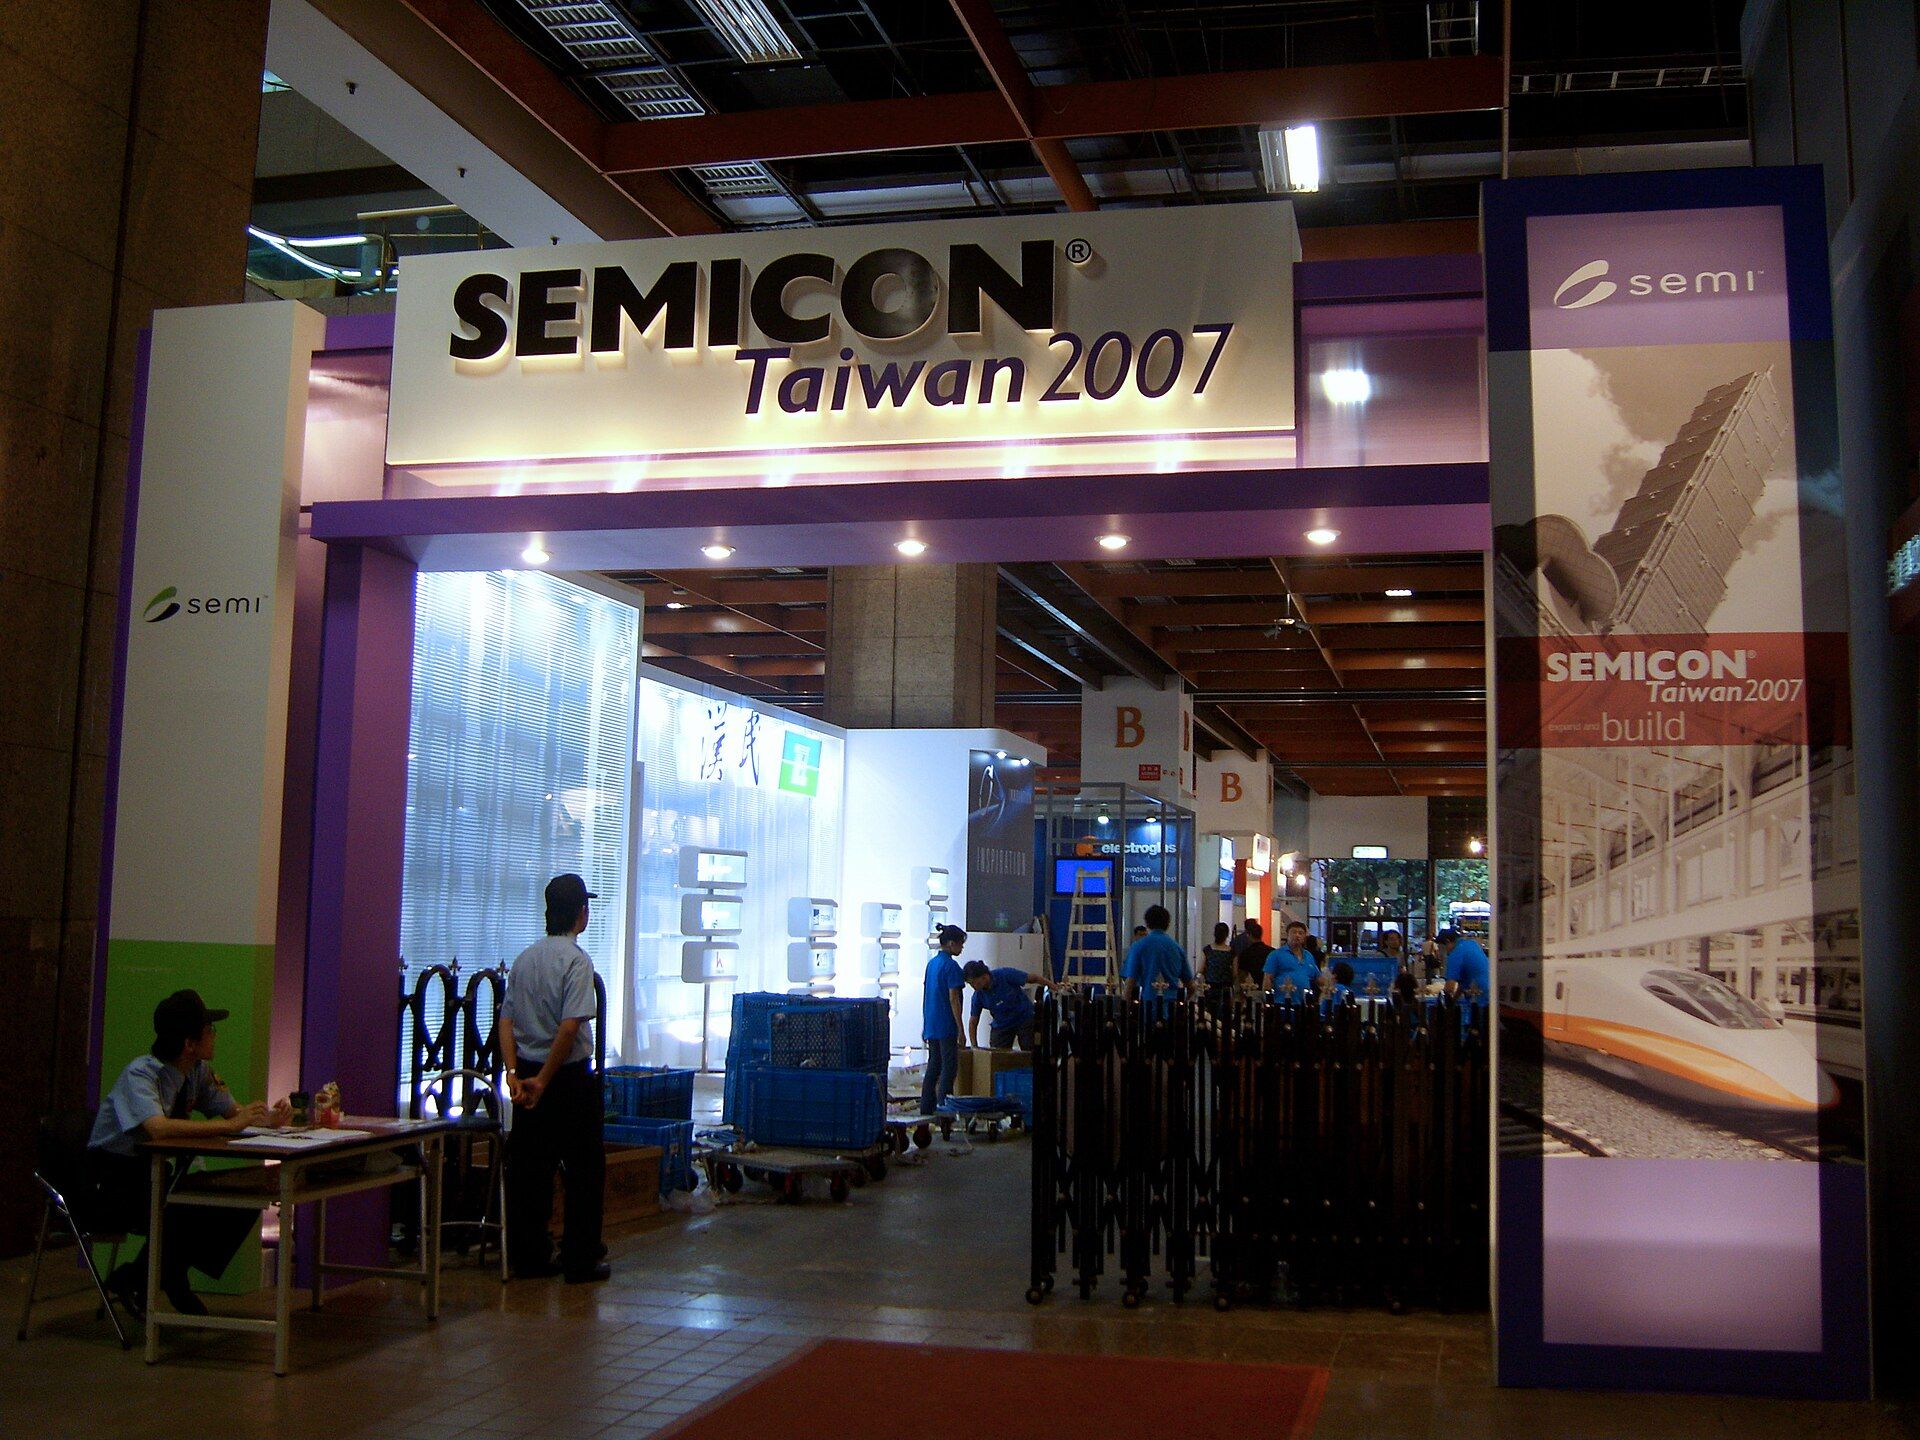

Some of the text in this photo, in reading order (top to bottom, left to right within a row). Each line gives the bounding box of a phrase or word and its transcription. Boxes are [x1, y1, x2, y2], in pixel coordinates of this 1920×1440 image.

[735, 322, 1235, 416] Taiwan 2007
[1646, 678, 1803, 703] Taiwan 2007
[1115, 706, 1145, 748] B
[1602, 710, 1686, 742] build
[1220, 772, 1243, 802] B
[1132, 875, 1150, 883] Tools
